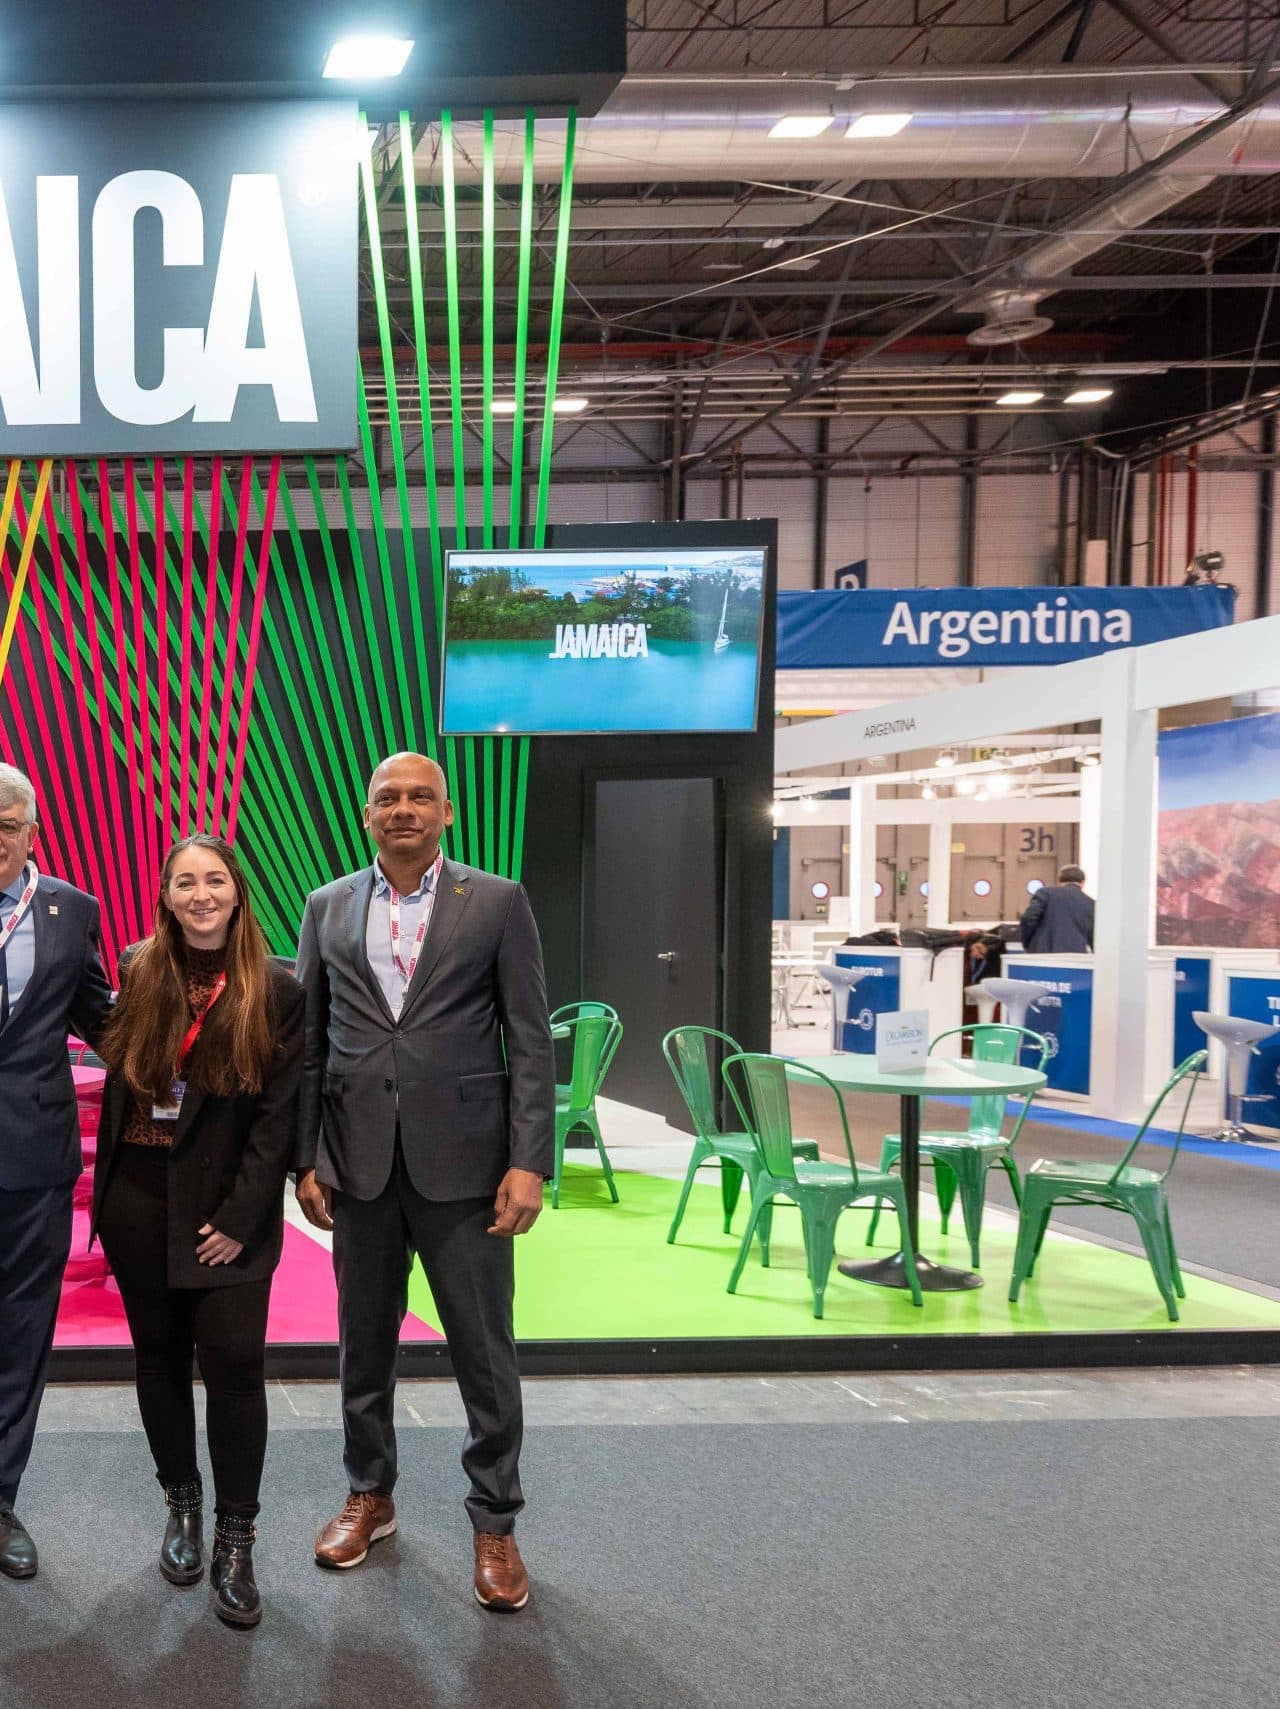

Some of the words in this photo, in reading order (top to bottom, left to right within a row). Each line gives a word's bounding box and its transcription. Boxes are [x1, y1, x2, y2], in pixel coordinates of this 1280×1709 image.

[548, 622, 649, 659] JAMAICA
[882, 597, 1132, 658] Argentina
[863, 718, 917, 740] ARGENTINA
[1020, 826, 1055, 853] 3h
